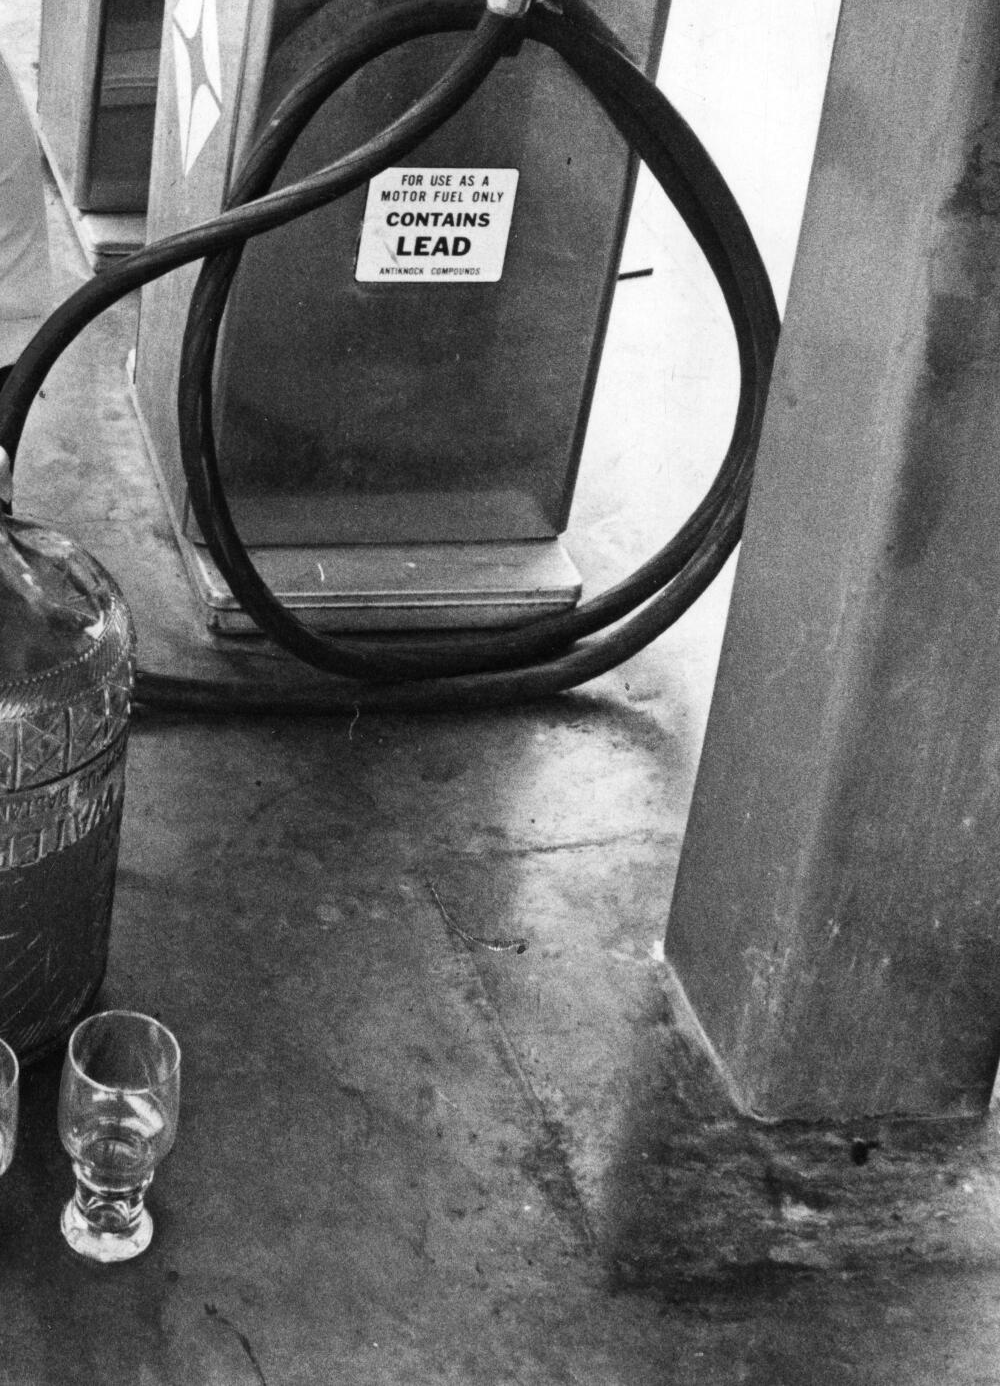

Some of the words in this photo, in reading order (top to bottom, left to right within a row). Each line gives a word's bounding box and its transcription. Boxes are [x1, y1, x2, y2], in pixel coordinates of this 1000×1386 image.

[401, 174, 423, 187] FOR
[430, 175, 452, 187] USE
[459, 175, 475, 187] AS
[482, 176, 489, 187] A
[381, 190, 426, 202] MOTOR
[433, 191, 464, 202] FUEL
[472, 191, 504, 203] ONLY
[386, 212, 490, 227] CONTAINS
[396, 236, 471, 256] LEAD
[379, 267, 424, 275] ANTIKNOCK
[431, 267, 480, 275] COMPOUNDS
